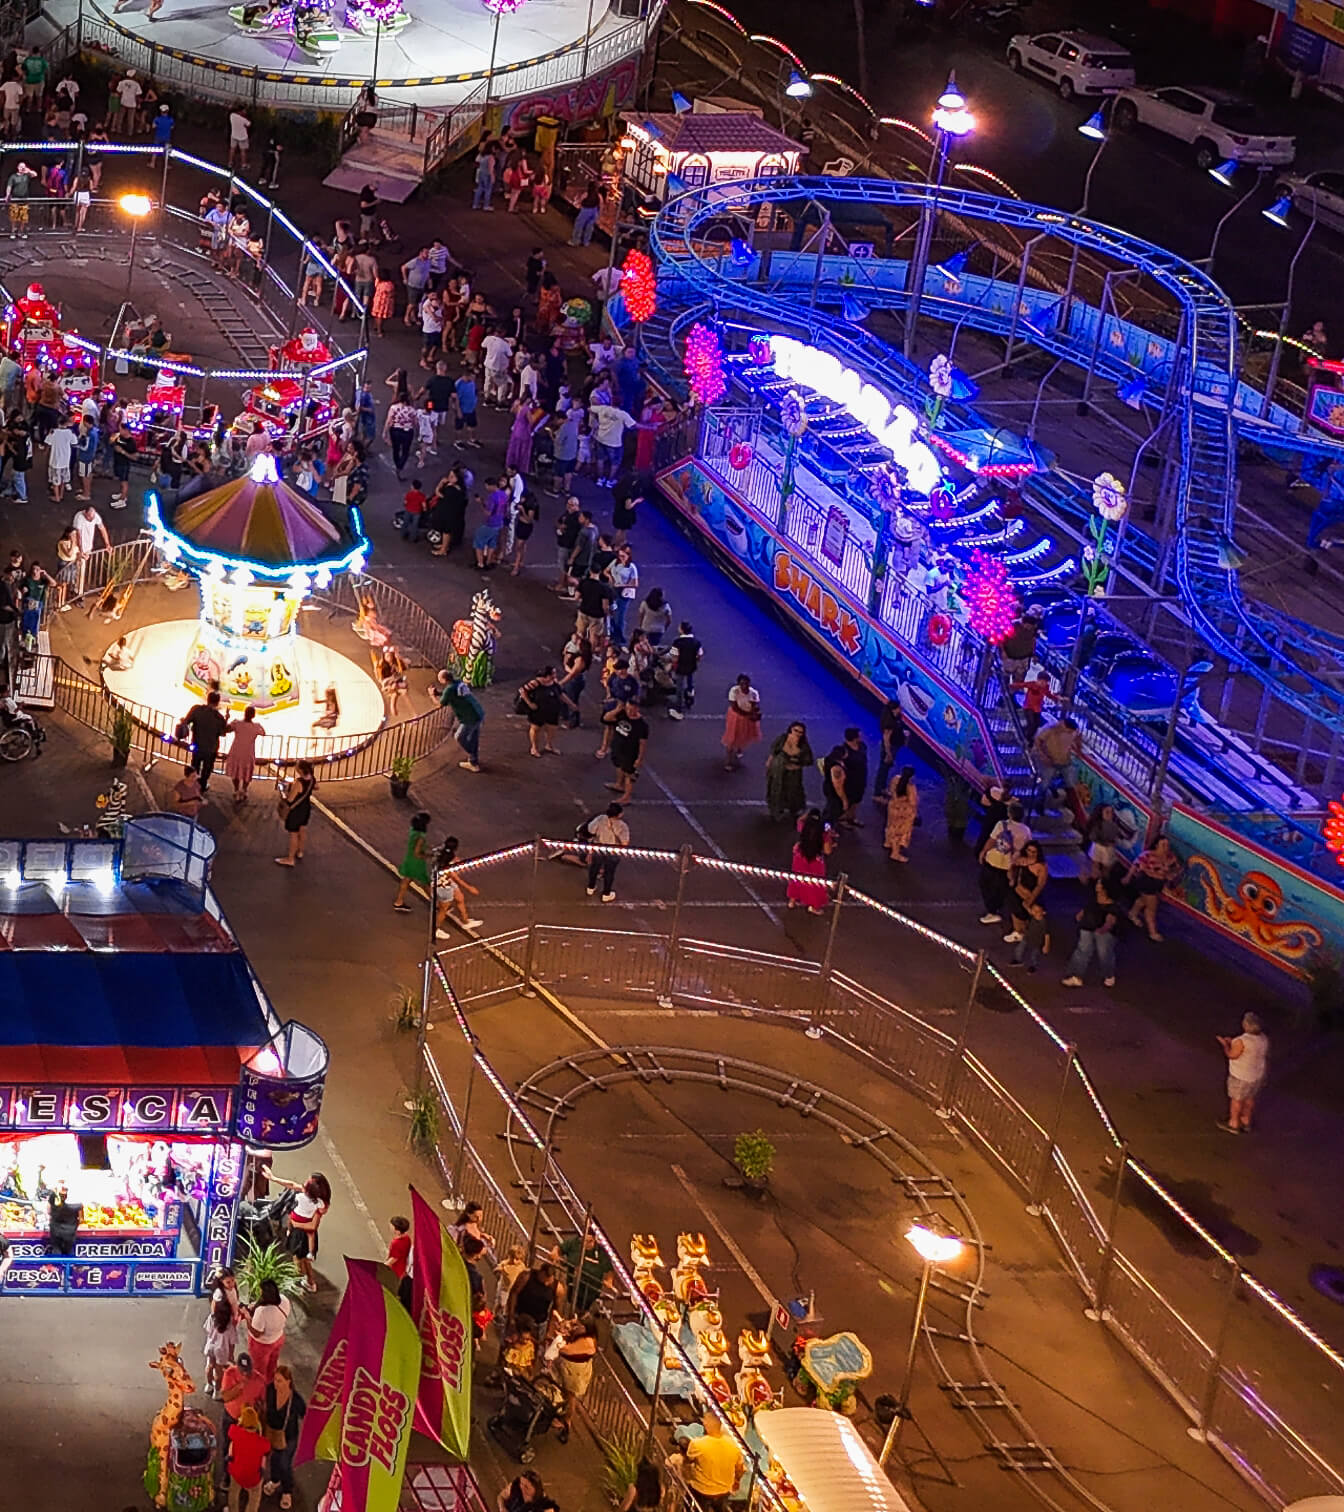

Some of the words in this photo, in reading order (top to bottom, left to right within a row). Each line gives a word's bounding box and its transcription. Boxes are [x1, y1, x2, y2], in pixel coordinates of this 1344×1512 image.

[774, 550, 863, 656] SHARK
[7, 1269, 60, 1282] PESCA
[134, 1271, 191, 1282] PREMIADA
[76, 1244, 167, 1257] PREMIADA
[342, 1367, 382, 1467] CANDY
[369, 1380, 410, 1477] FLOSS
